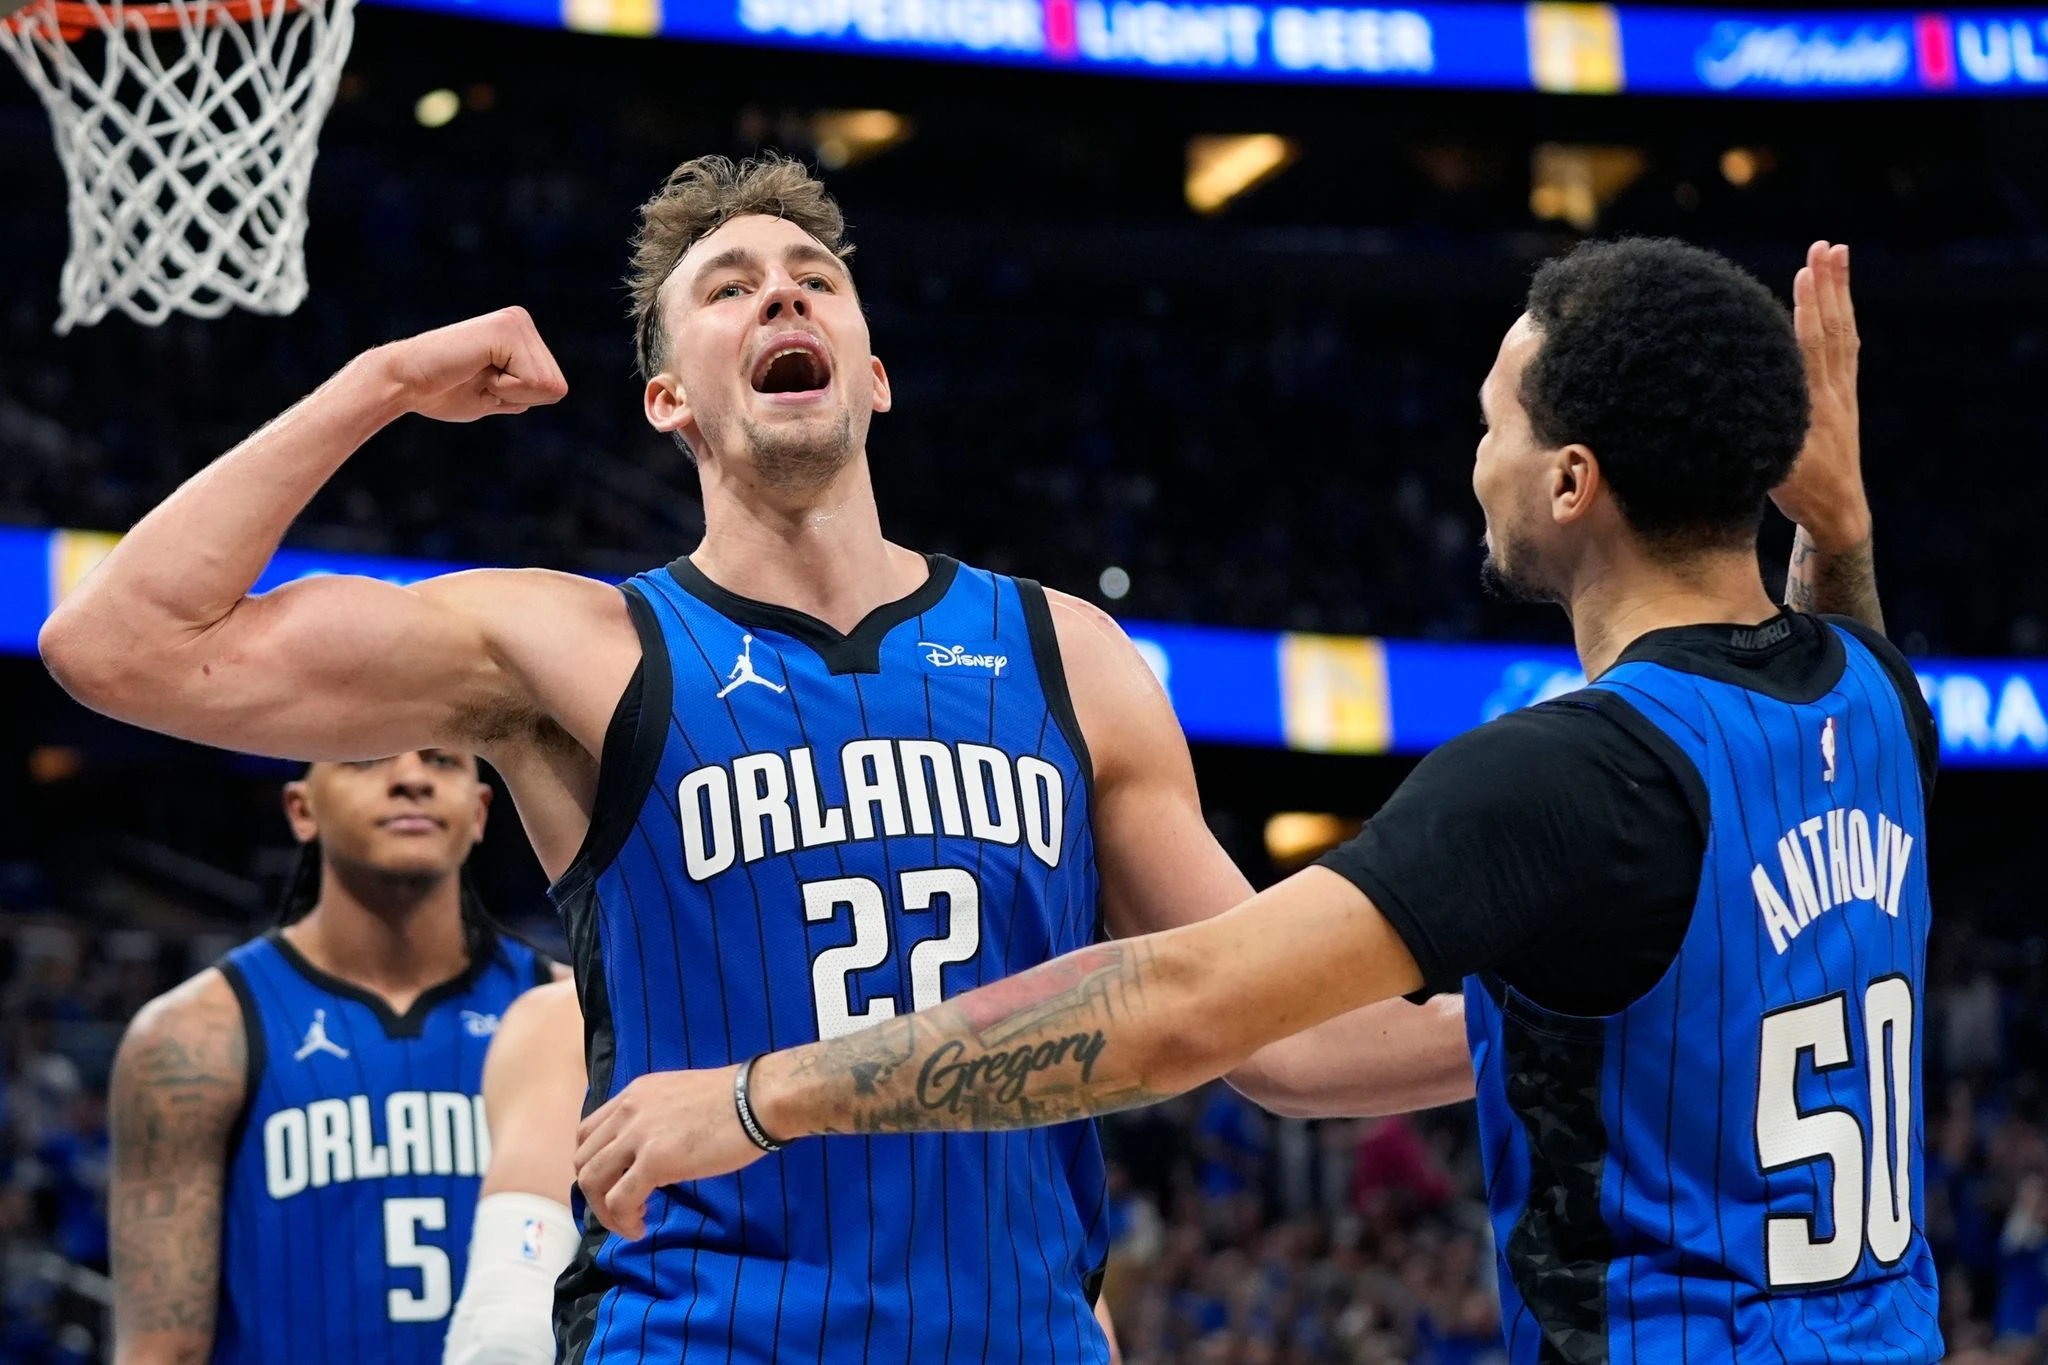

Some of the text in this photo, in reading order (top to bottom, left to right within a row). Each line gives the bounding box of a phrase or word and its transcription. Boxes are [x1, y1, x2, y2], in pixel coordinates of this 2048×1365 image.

[1080, 2, 1258, 66] LIGHT
[1271, 8, 1433, 72] BEER
[1957, 18, 2048, 84] UL
[1917, 673, 2048, 752] RA
[676, 738, 1065, 883] ORLANDO
[1751, 807, 1914, 956] ANTHONY
[801, 867, 980, 1041] 22
[916, 1029, 1107, 1114] Gregory
[1756, 976, 1914, 1290] 50
[383, 1196, 453, 1323] 5
